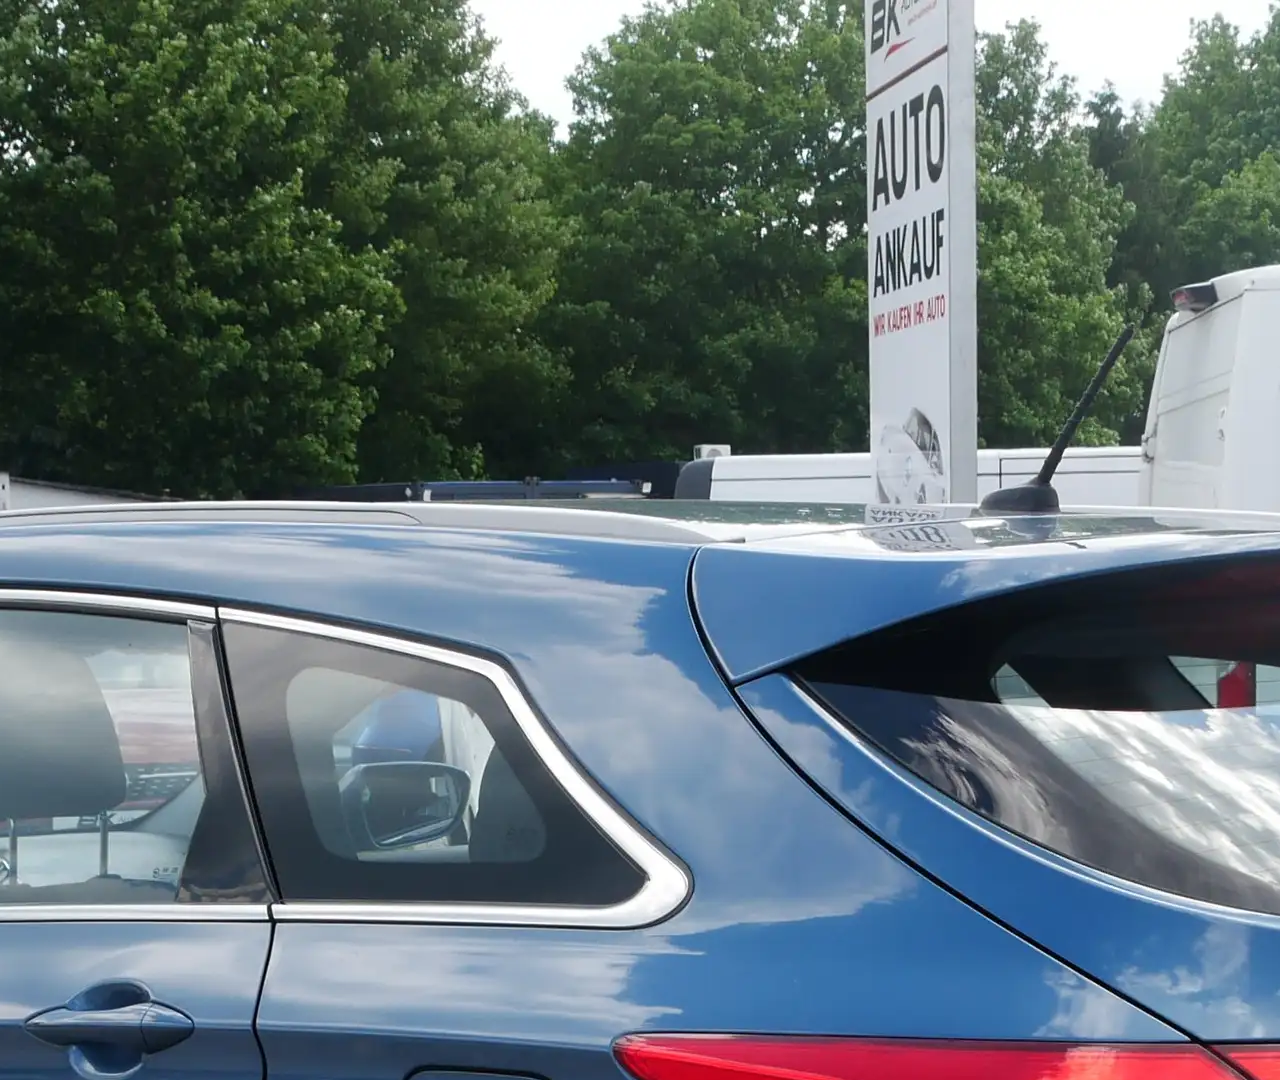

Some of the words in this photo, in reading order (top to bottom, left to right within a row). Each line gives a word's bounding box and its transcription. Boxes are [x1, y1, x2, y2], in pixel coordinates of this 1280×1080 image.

[872, 84, 946, 212] AUTO
[873, 208, 945, 298] ANKAUF
[873, 313, 886, 338] WIR
[887, 303, 912, 333] KAUFEN
[913, 300, 925, 326] IHR
[926, 294, 946, 322] AUTO
